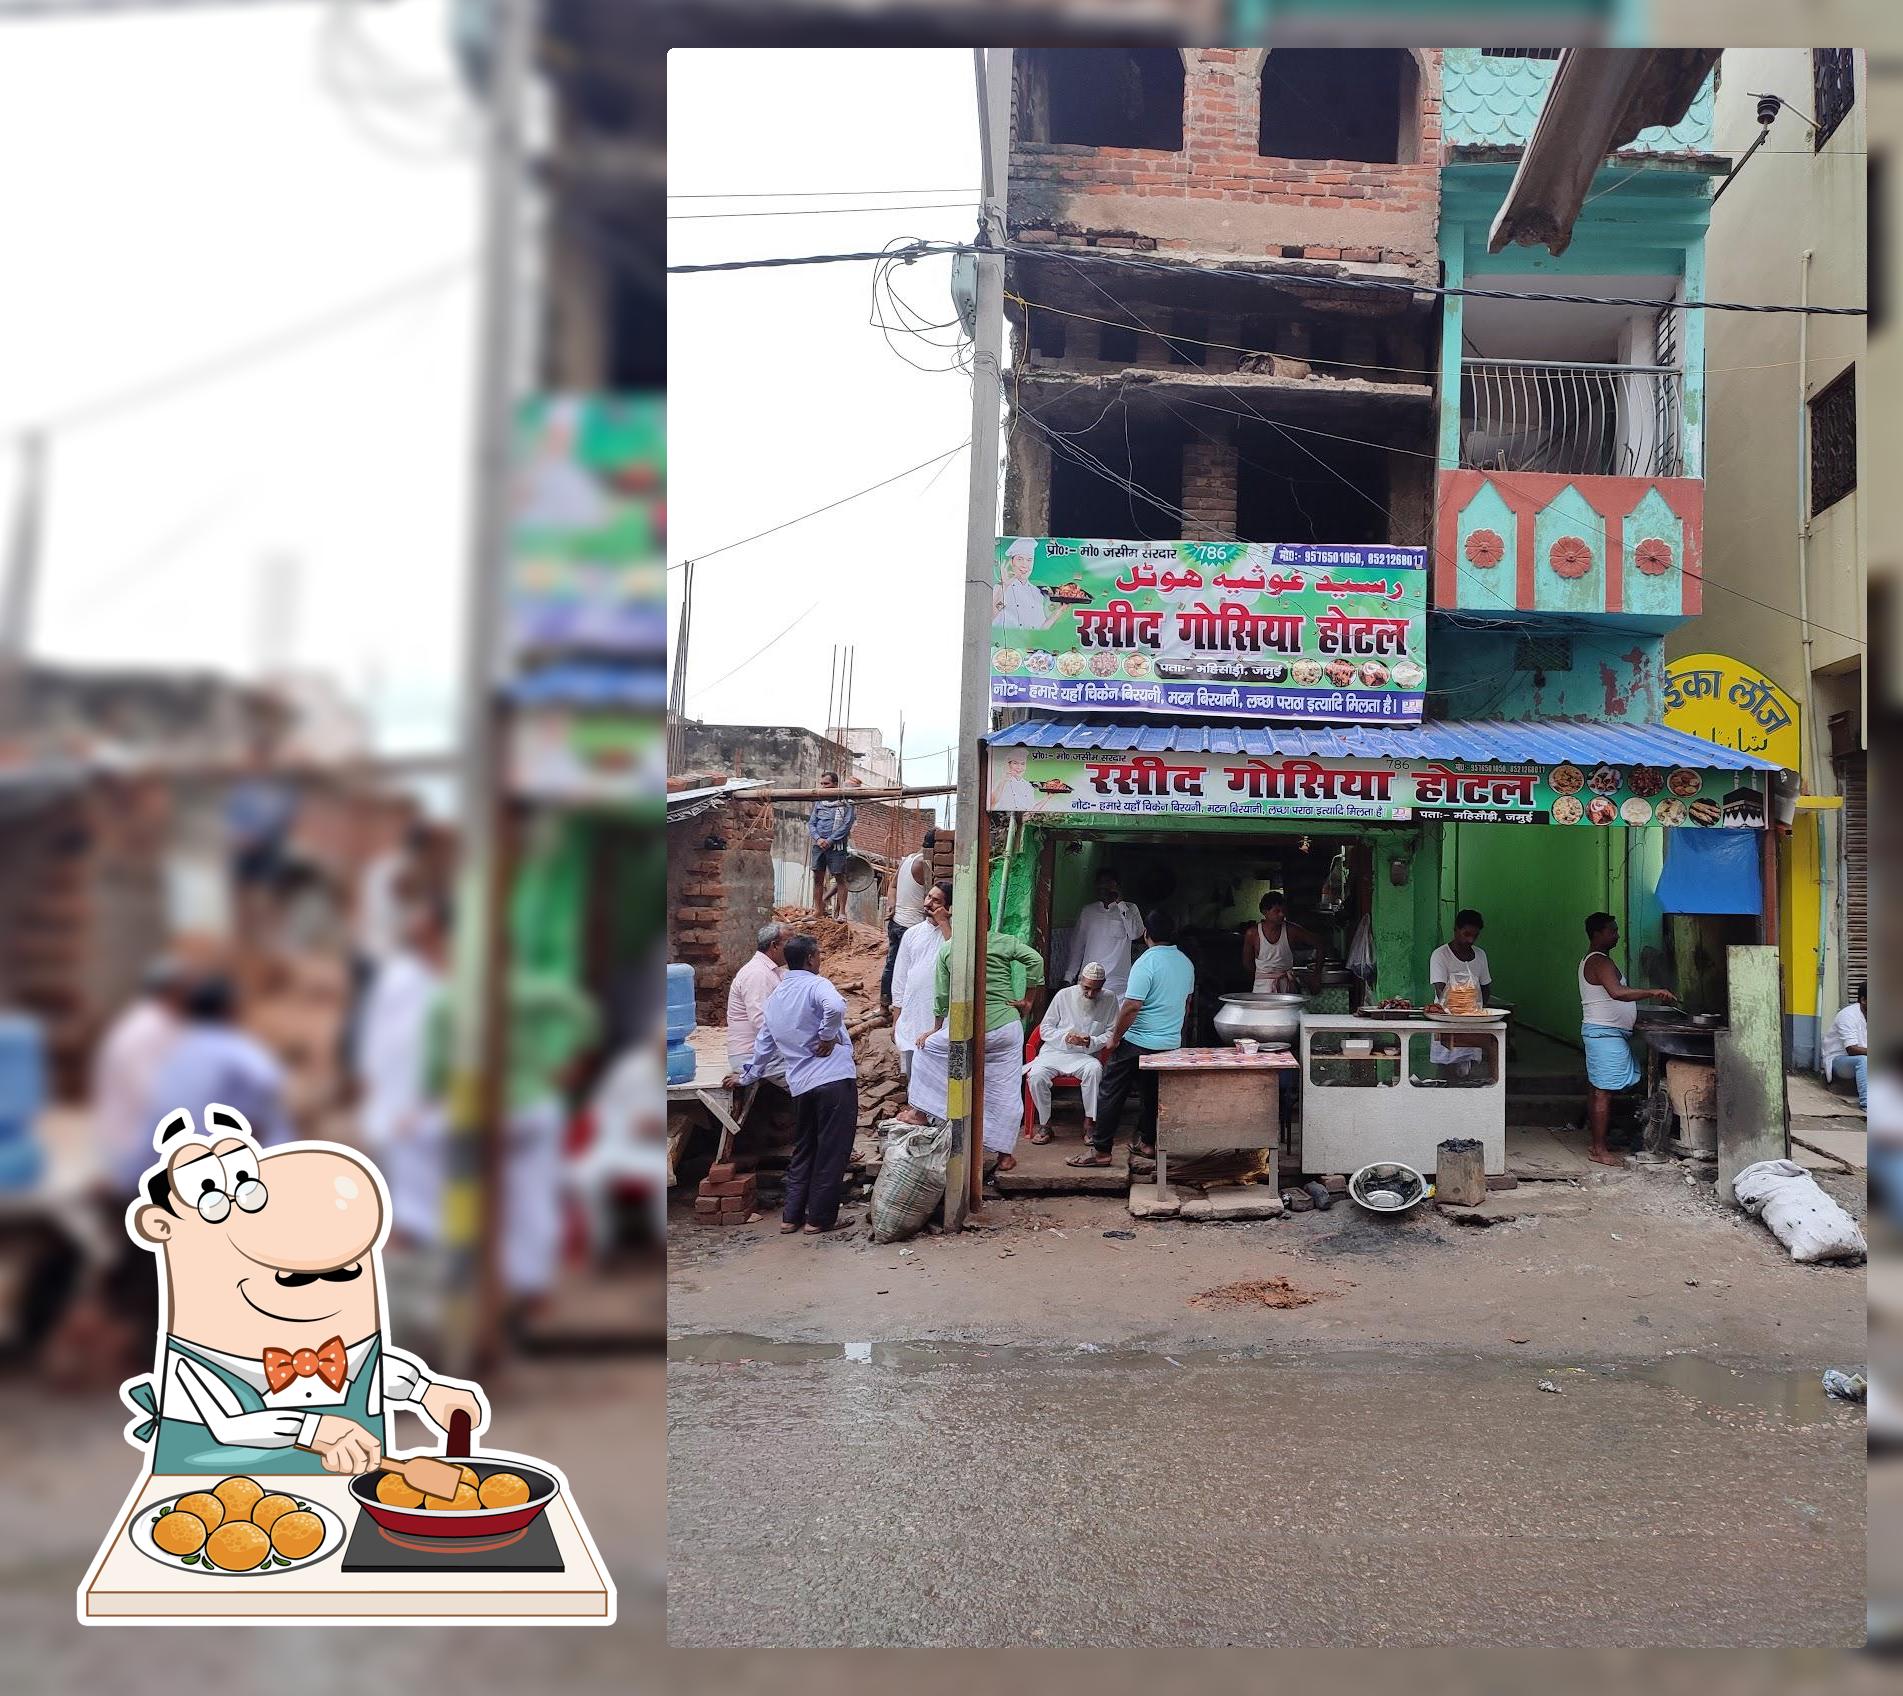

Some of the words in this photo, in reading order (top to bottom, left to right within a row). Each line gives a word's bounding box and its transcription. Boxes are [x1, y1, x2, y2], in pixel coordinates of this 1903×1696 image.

[1103, 544, 1138, 559] जसीम
[1142, 549, 1177, 559] सरदार
[1198, 546, 1227, 560] 786
[1073, 600, 1164, 650] रसीद
[1176, 602, 1304, 654] गोसिया
[1316, 606, 1410, 656] होटल
[1251, 665, 1283, 680] जमुई
[1029, 683, 1058, 700] हमारे
[1060, 682, 1083, 702] यहाँ
[1168, 690, 1194, 706] मटन
[1276, 695, 1304, 711] पराठा
[1307, 693, 1343, 713] इत्यादि
[1345, 693, 1380, 714] मिलता
[1728, 676, 1792, 734] लॉज
[1073, 752, 1099, 761] जसीम
[1101, 754, 1127, 762] सरदार
[1386, 759, 1410, 770] 786
[1085, 755, 1207, 798] रसीद
[1224, 759, 1396, 801] गोसिया
[1411, 763, 1539, 807] होटल
[1100, 799, 1121, 811] हमारे
[1123, 799, 1140, 812] यहाँ
[1207, 804, 1226, 814] मटन
[1292, 806, 1313, 816] पराठा
[1316, 804, 1344, 816] इत्यादि
[1346, 804, 1374, 817] मिलता
[1505, 810, 1533, 823] जमुई
